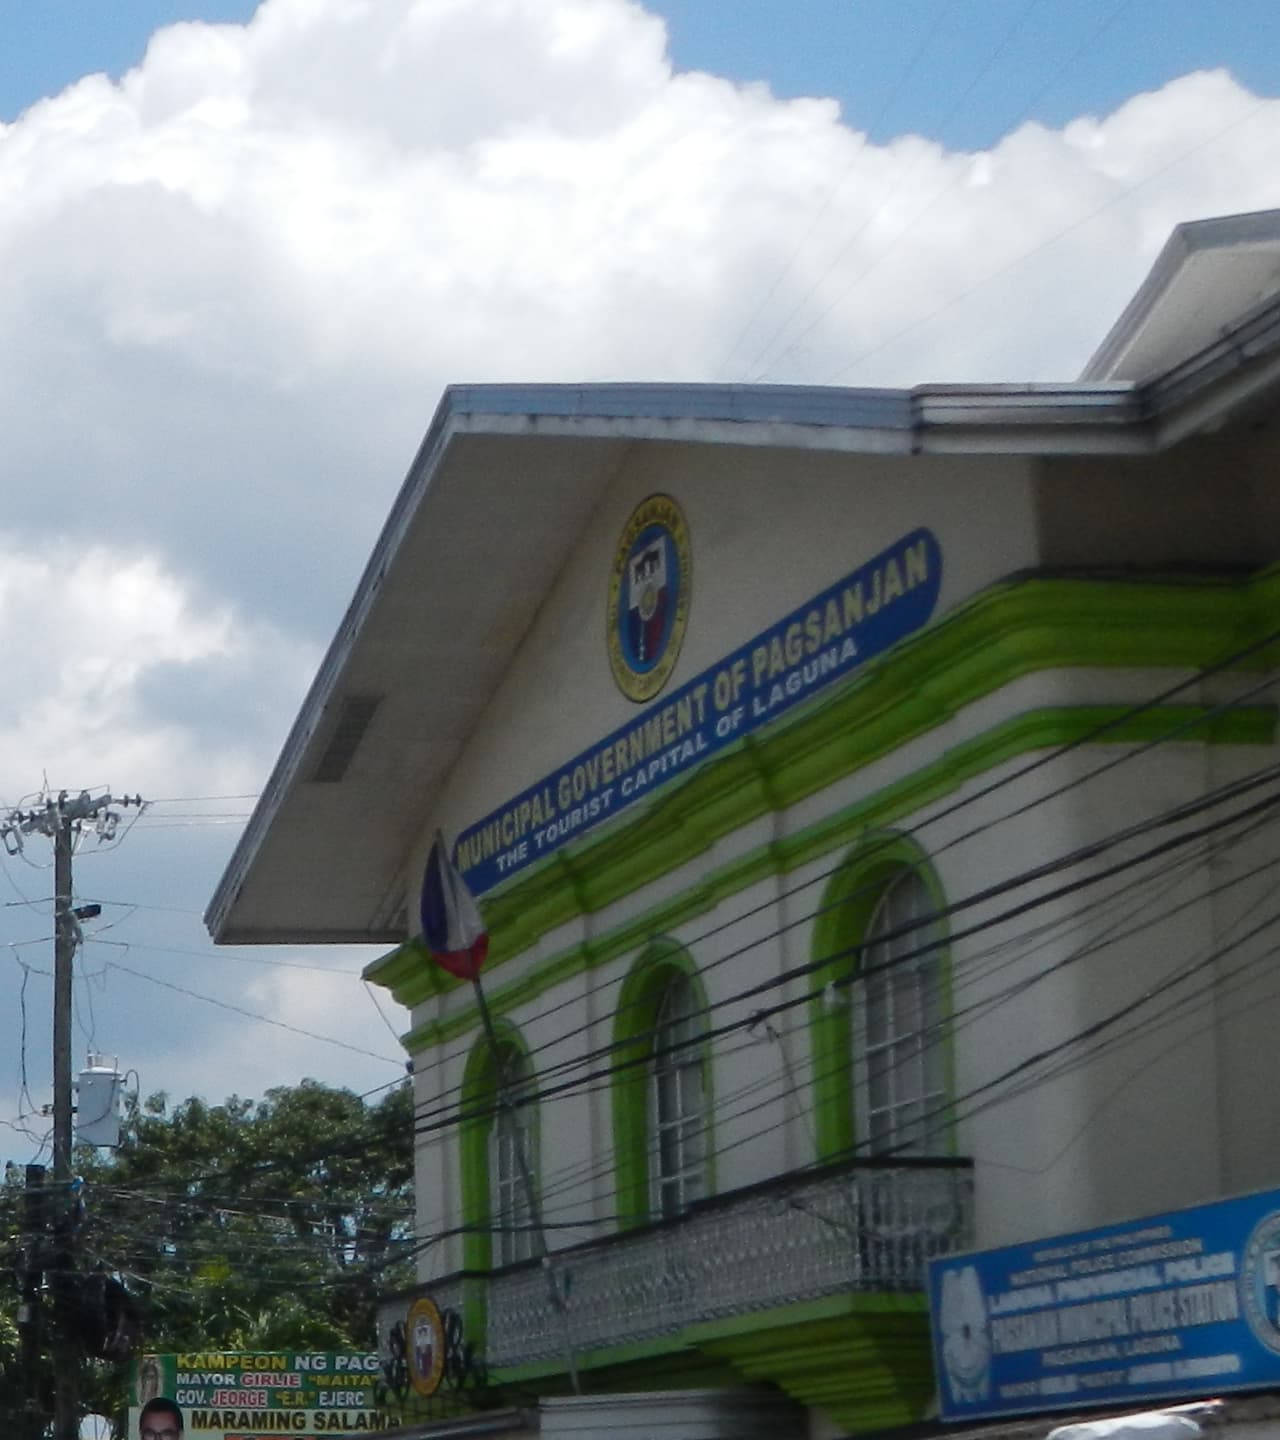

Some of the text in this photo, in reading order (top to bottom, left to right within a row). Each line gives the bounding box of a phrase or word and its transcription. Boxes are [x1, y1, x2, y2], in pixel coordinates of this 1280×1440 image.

[457, 787, 555, 873] MUNICIPAL
[558, 681, 707, 810] GOVERNMENT
[714, 658, 746, 711] OF
[752, 539, 928, 688] PAGSANJAN
[496, 636, 858, 873] THE TOURIST CAPITAL OF LAGUNA
[176, 1354, 287, 1370] KAMPEON
[294, 1355, 327, 1370] NG
[176, 1373, 236, 1385] MAYOR
[240, 1373, 301, 1387] GIRLIE
[176, 1390, 207, 1405] GOV.
[210, 1389, 268, 1407] JEORGE
[191, 1410, 307, 1430] MARAMING
